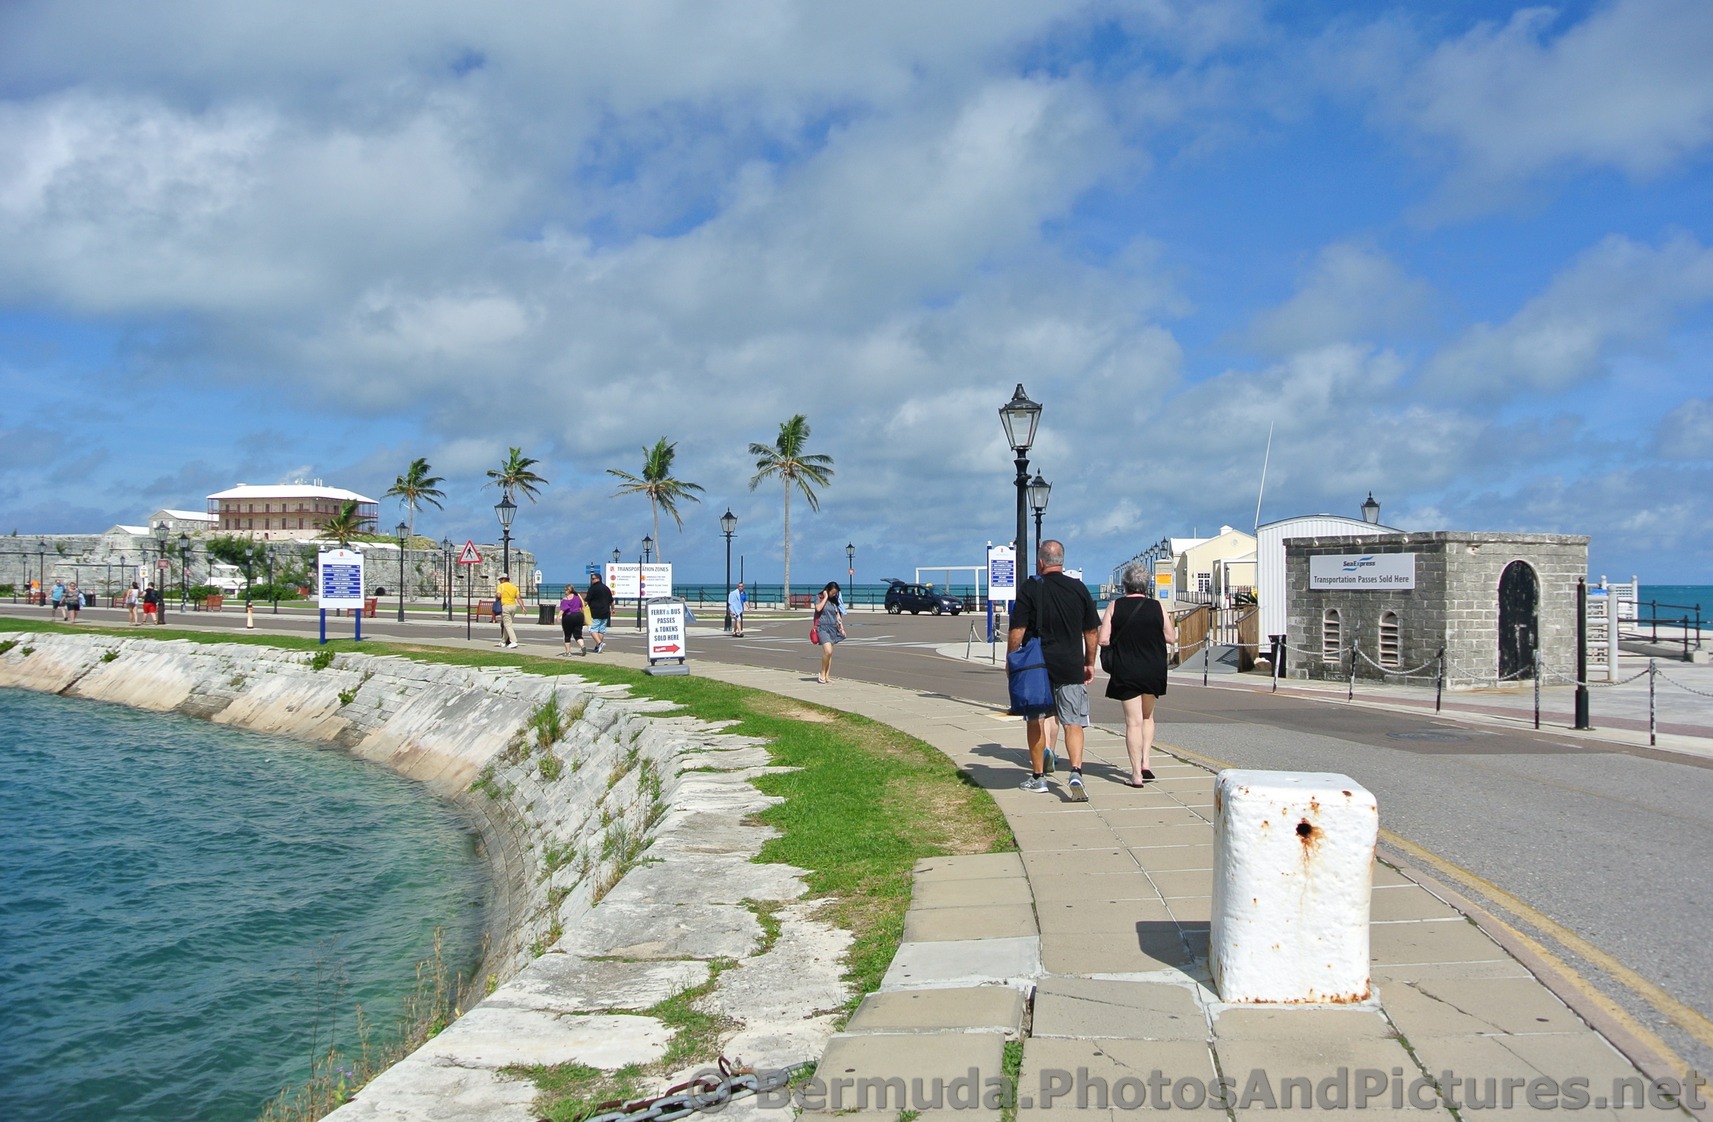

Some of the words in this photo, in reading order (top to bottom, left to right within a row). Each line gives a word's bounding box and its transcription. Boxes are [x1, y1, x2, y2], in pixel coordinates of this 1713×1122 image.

[1314, 575, 1356, 585] Transportation
[1357, 575, 1378, 584] Passes
[1379, 575, 1392, 583] Sold
[1394, 575, 1410, 583] Here
